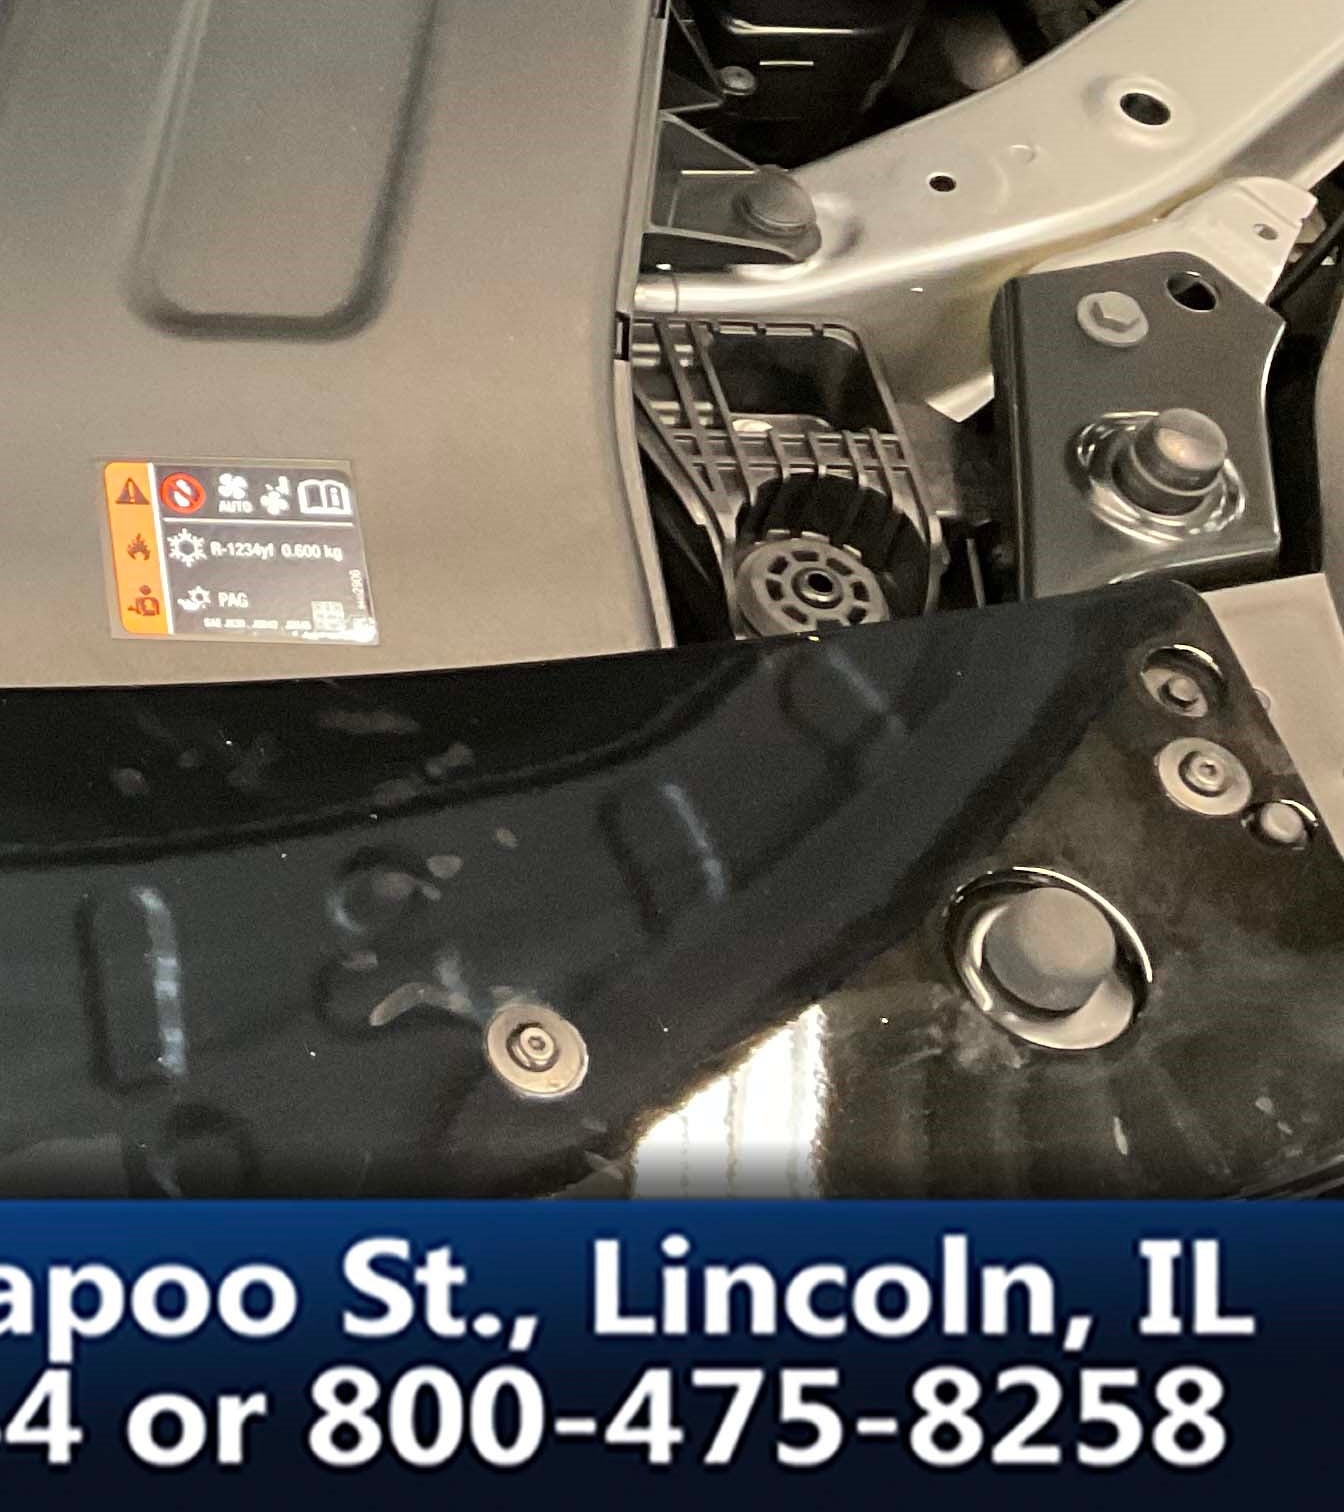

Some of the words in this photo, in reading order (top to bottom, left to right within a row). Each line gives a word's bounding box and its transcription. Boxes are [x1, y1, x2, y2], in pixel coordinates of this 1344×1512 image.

[218, 500, 254, 513] AUTO
[211, 541, 275, 560] R-1234yf
[323, 545, 344, 561] kg
[217, 591, 249, 609] PAG
